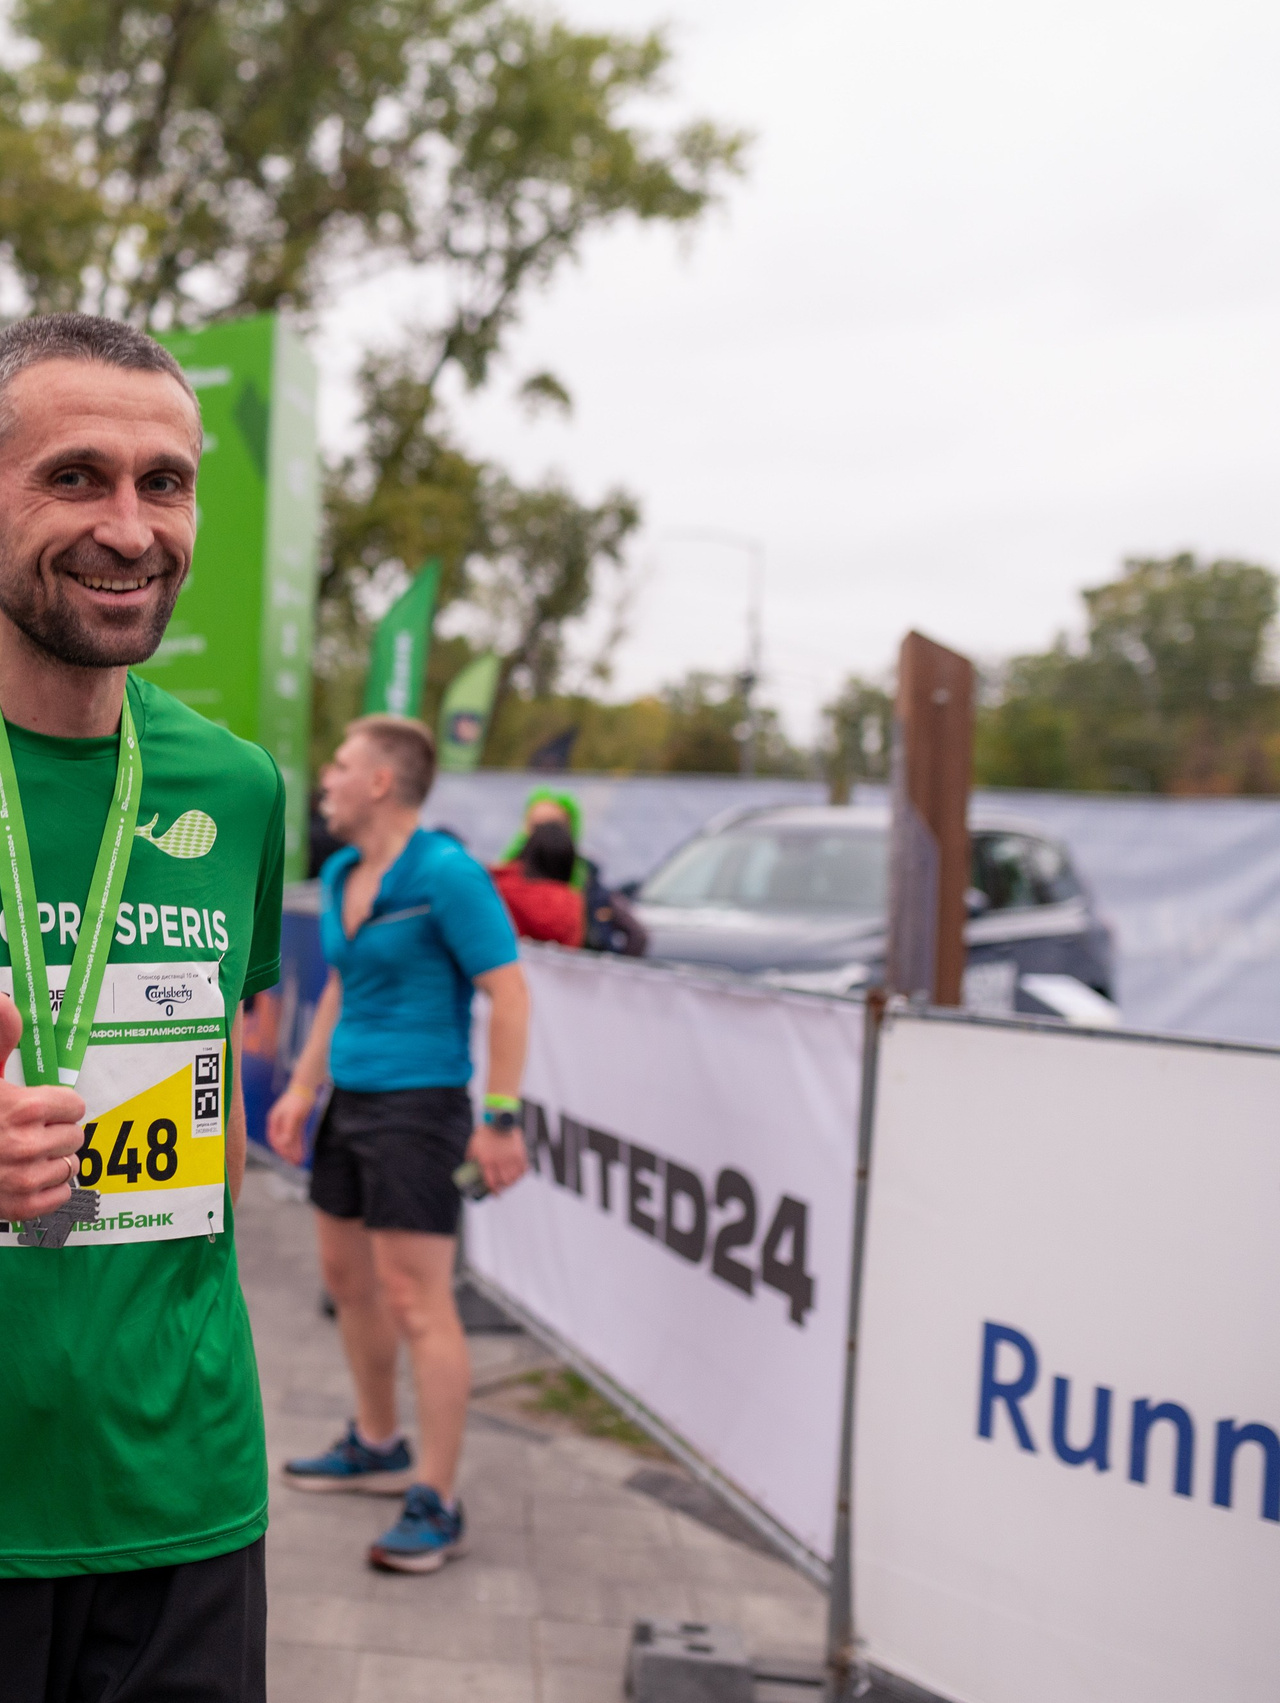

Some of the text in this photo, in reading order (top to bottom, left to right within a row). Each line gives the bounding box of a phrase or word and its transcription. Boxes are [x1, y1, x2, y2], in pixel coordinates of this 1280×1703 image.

[7, 834, 16, 858] 2024
[11, 859, 25, 924] НЕЗЛАМНОСТІ
[20, 925, 32, 971] МАРАФОН
[66, 1025, 77, 1051] ДЕНЬ
[78, 953, 94, 1004] КИЇВСЬКИЙ
[90, 909, 105, 954] МАРАФОН
[101, 847, 119, 909] НЕЗЛАМНОСТІ
[115, 825, 124, 848] 2024
[26, 971, 38, 1024] КИЇВСЬКИЙ
[145, 984, 193, 1005] Carlsberg
[165, 1004, 174, 1017] 0
[90, 1029, 122, 1038] АФОН
[124, 1026, 195, 1037] НЕЗЛАМНОСТІ
[197, 1024, 220, 1033] 2024
[35, 1047, 45, 1073] ДЕНЬ
[75, 1118, 178, 1187] 648
[73, 1211, 174, 1232] ватБанк
[977, 1319, 1280, 1523] Runn
